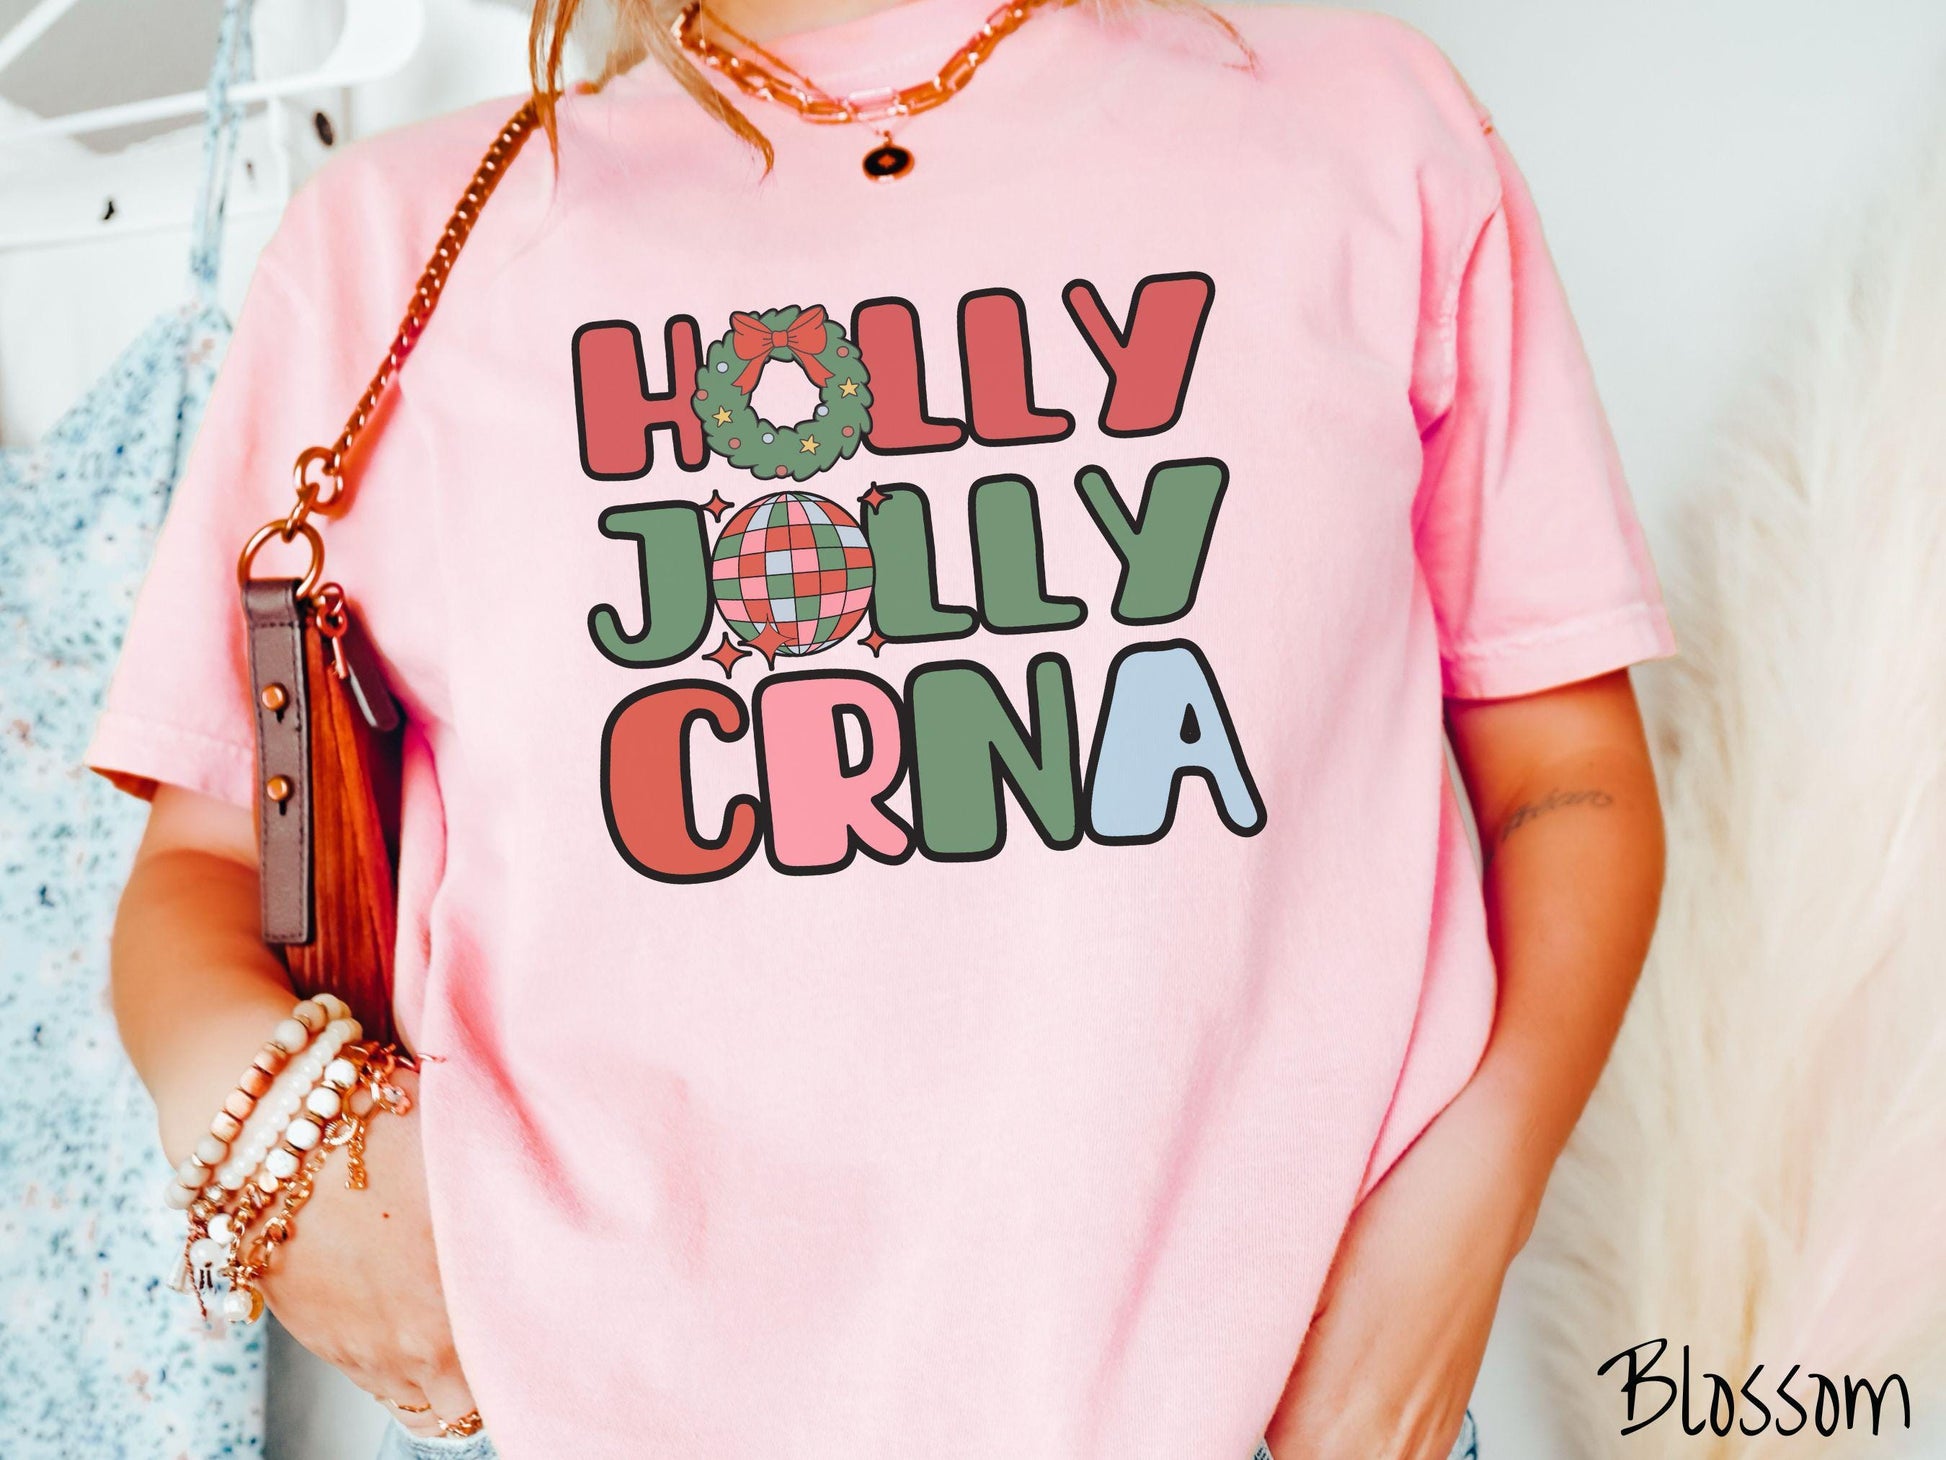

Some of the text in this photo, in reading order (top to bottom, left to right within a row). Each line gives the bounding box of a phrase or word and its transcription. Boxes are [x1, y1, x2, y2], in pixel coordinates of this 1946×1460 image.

[572, 272, 1215, 481] HOLLY
[588, 457, 1229, 670] JOLLY
[600, 638, 1268, 885] CRNA
